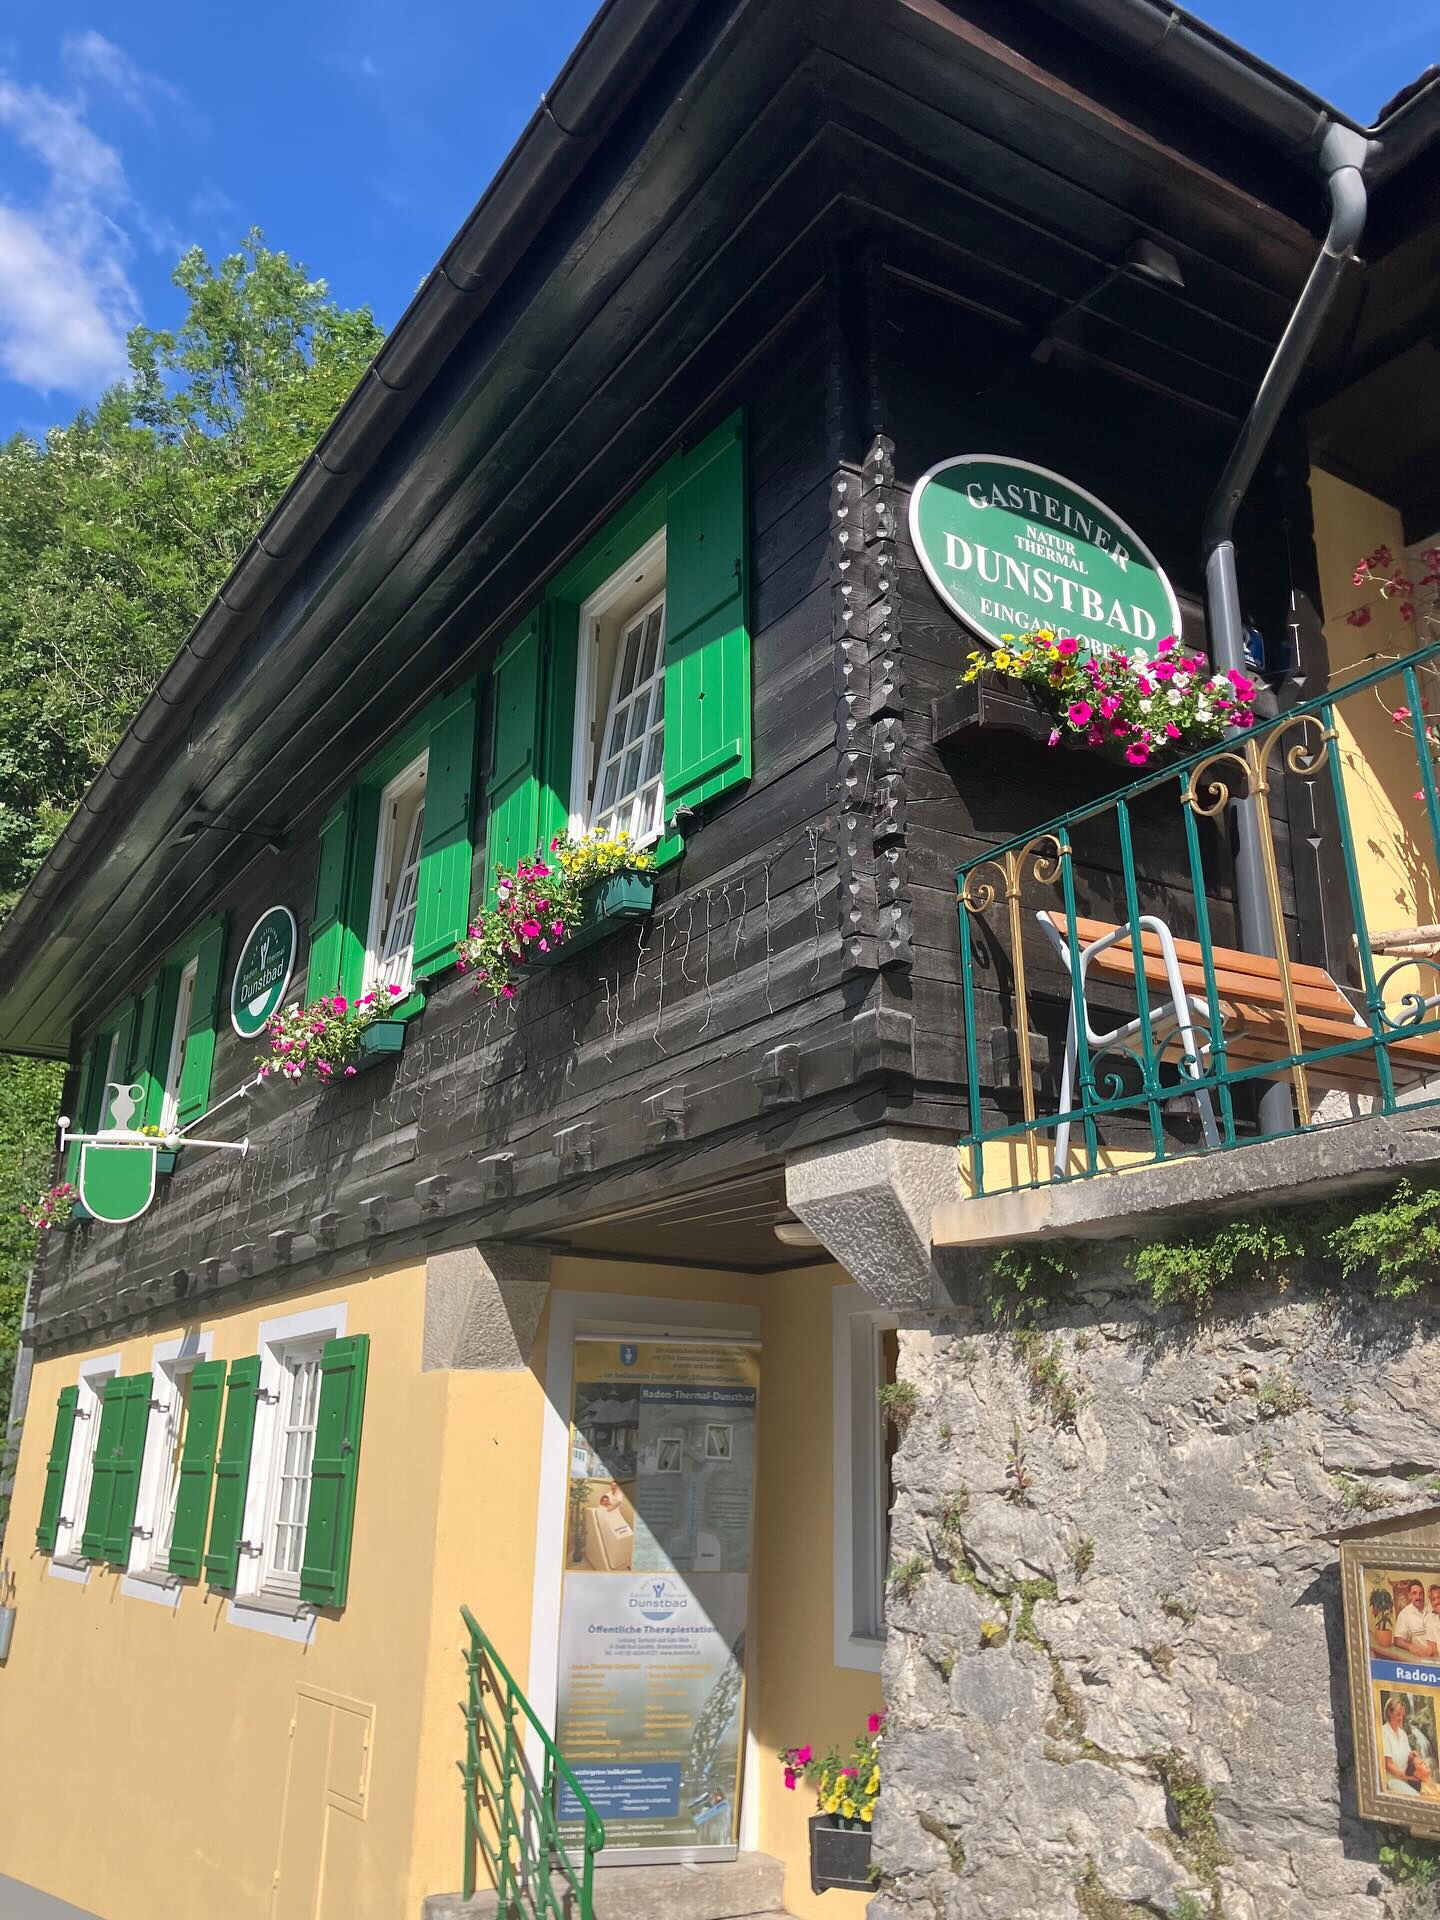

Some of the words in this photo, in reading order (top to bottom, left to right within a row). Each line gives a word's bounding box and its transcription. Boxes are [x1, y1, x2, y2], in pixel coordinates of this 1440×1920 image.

[966, 482, 1130, 573] GASTEINER
[1025, 524, 1076, 556] NATUR
[1014, 535, 1089, 575] THERMAL
[943, 531, 1156, 641] DUNSTBAD
[1076, 634, 1126, 661] OBE
[240, 958, 284, 1003] Dunstbad
[642, 1389, 755, 1402] Radon-Thermal-Dunstbad
[628, 1598, 688, 1608] Dunstbad
[588, 1624, 642, 1634] Öffentliche
[644, 1625, 720, 1635] Therapiestation
[1396, 1666, 1440, 1683] Radon-
